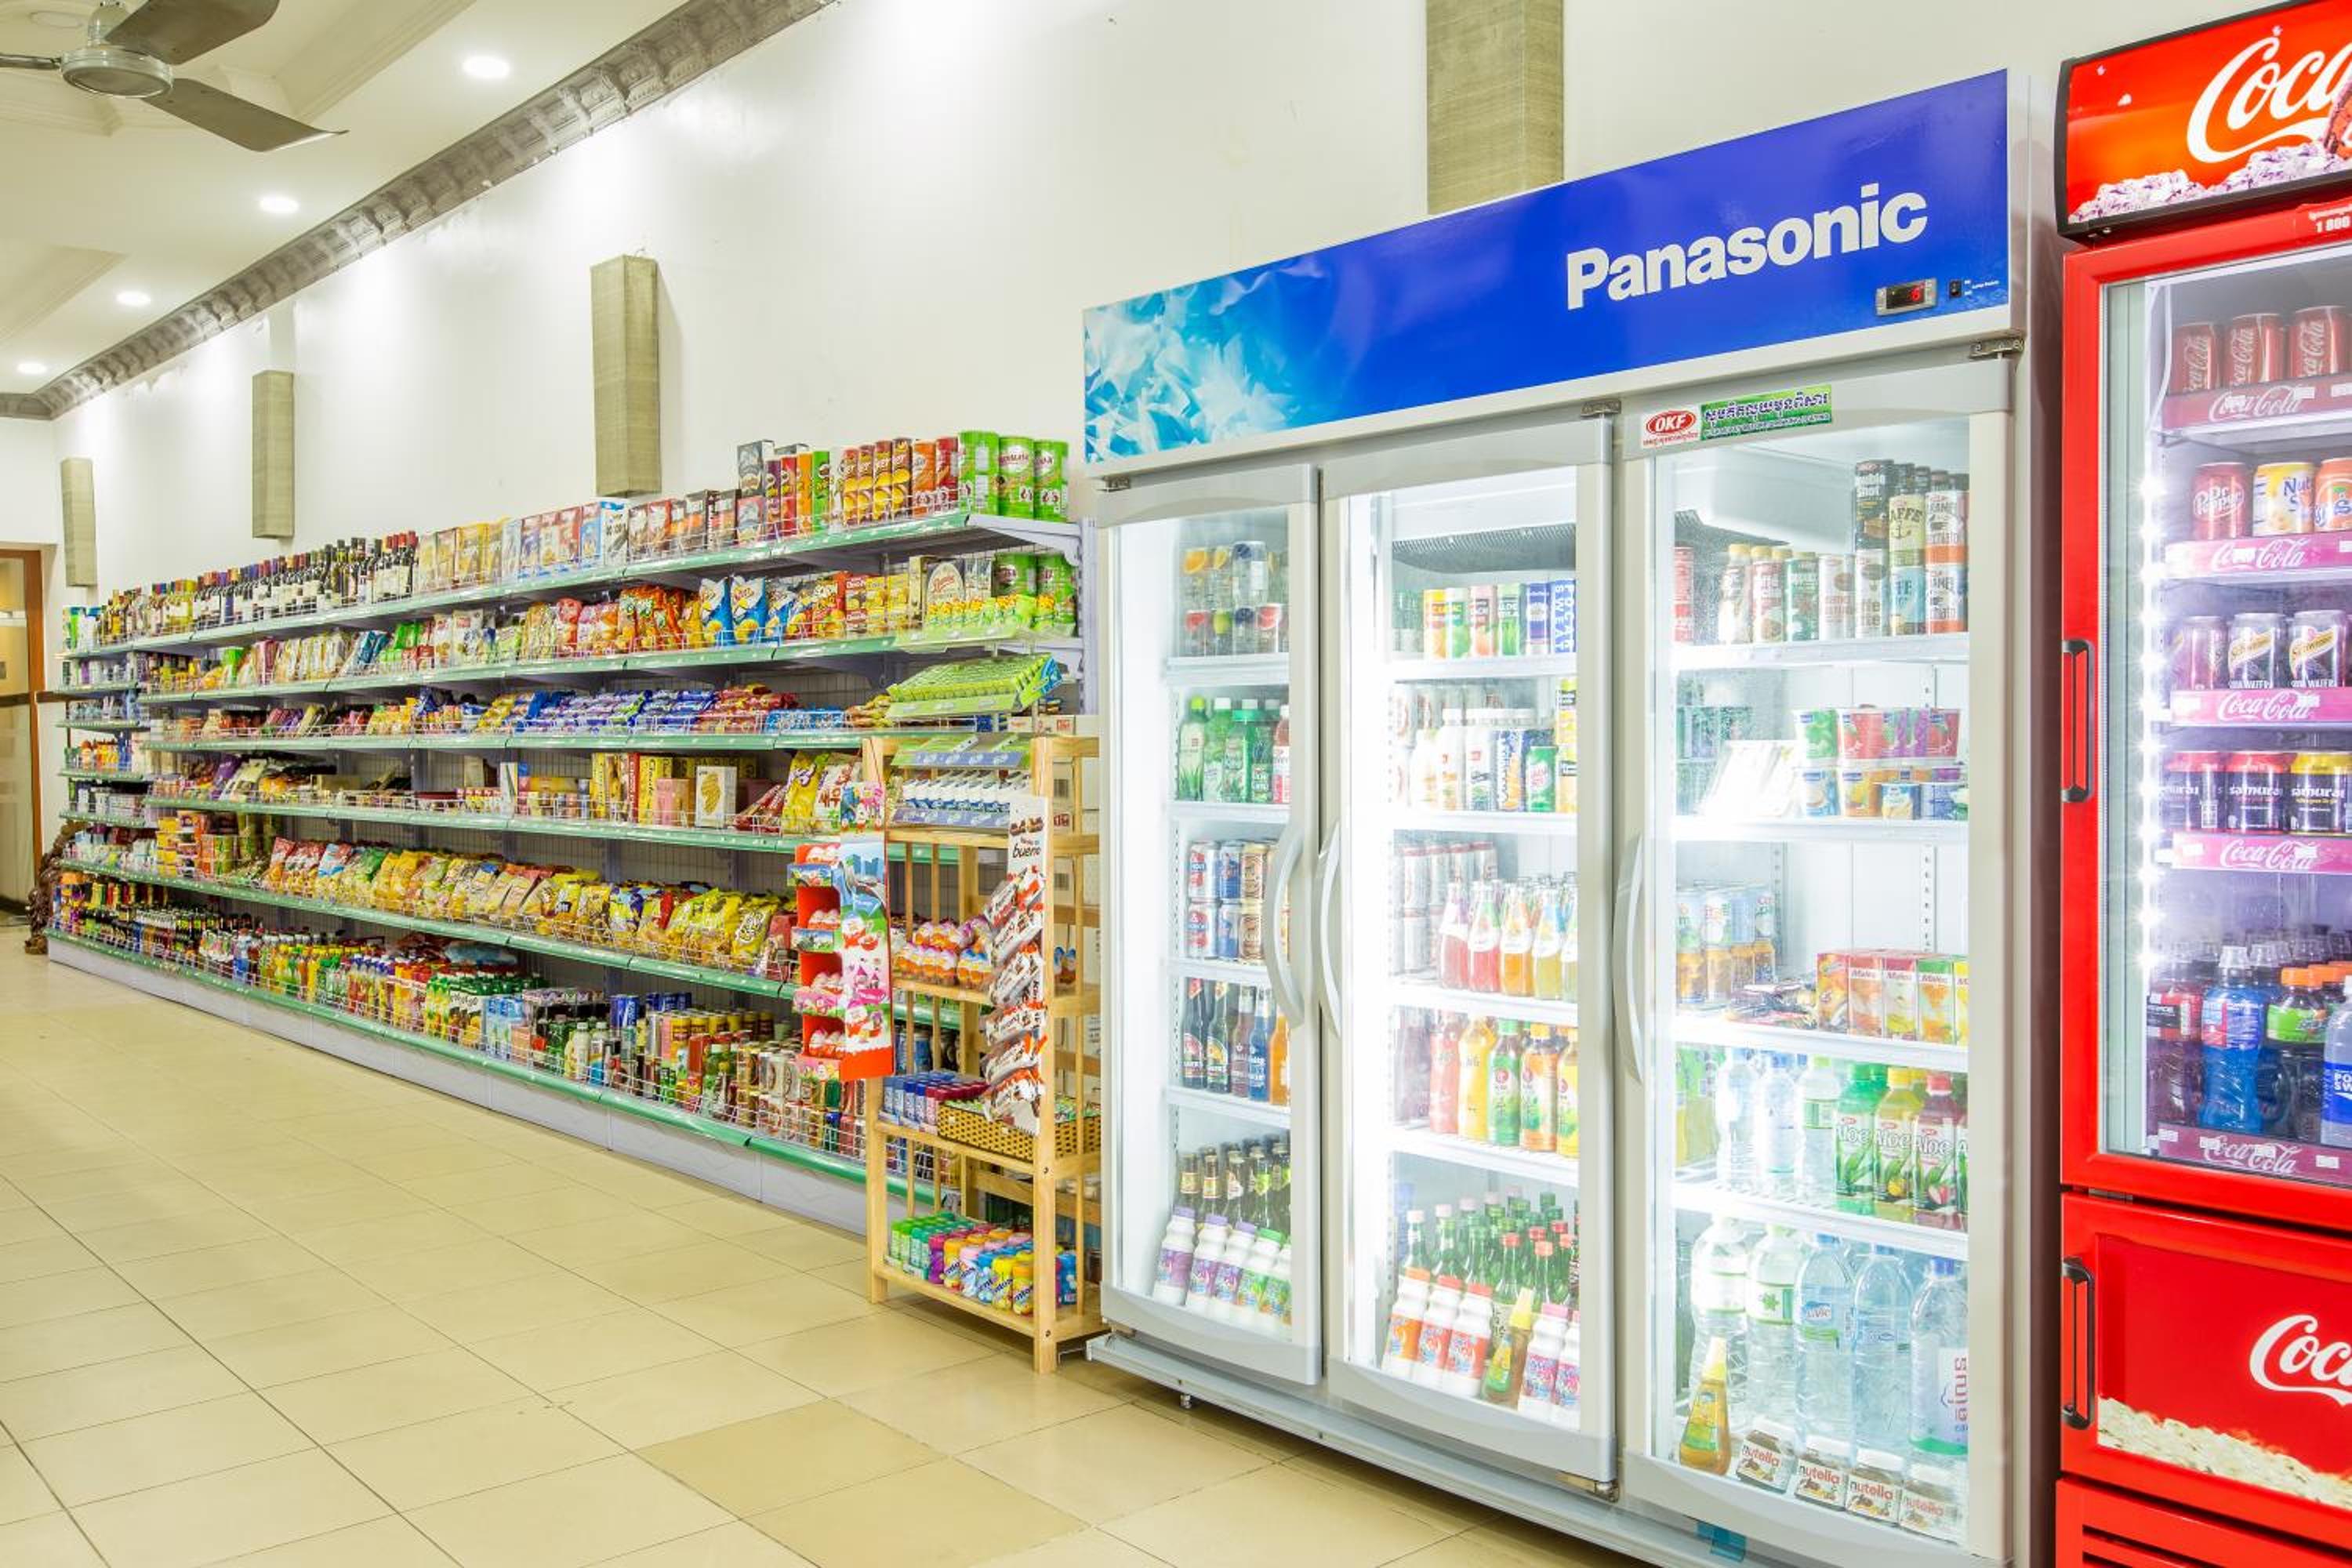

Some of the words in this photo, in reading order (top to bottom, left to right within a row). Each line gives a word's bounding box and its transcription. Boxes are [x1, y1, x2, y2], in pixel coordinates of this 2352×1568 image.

[1567, 182, 1928, 310] Panasonic
[1654, 414, 1687, 432] OKF
[1012, 843, 1041, 858] bueno
[1742, 1444, 1780, 1468] nutella
[1799, 1463, 1840, 1486] nutella
[1849, 1480, 1894, 1501] nutella
